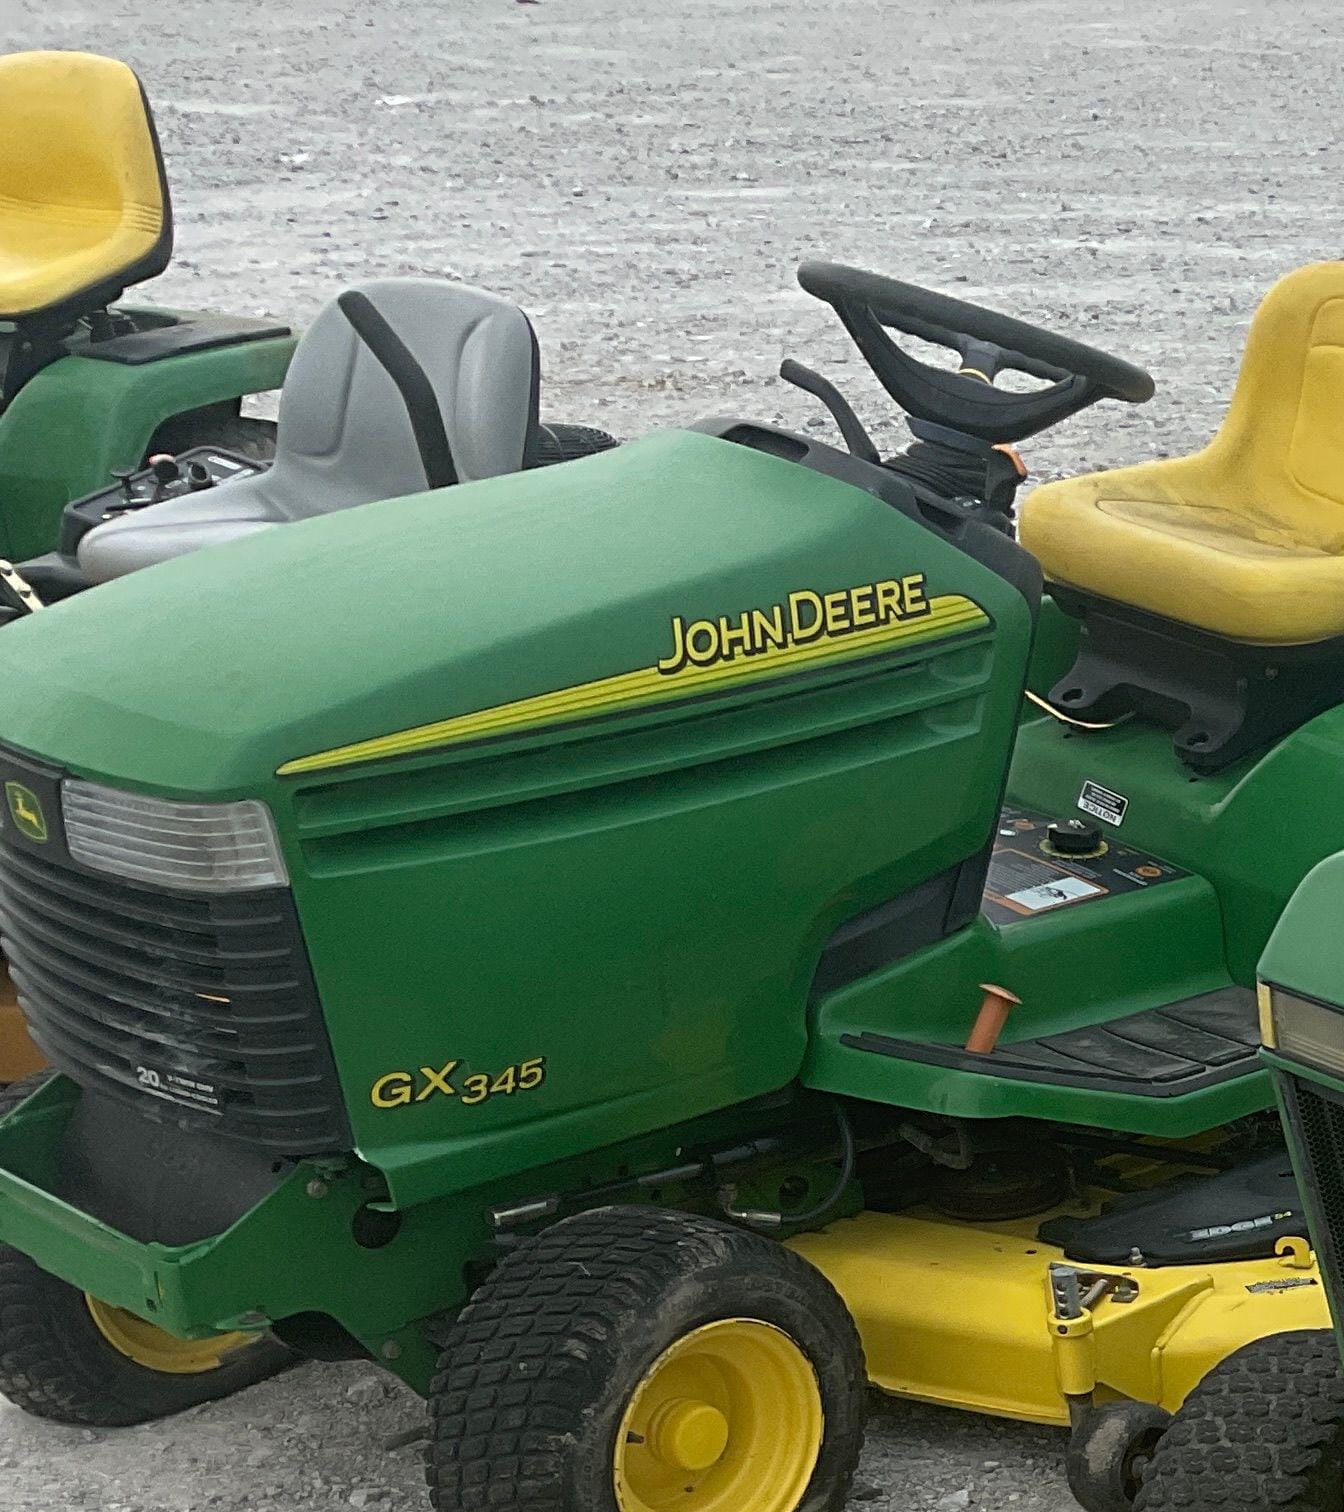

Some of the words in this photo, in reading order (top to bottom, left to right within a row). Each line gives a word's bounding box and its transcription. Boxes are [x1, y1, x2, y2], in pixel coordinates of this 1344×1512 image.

[658, 604, 786, 675] JOHN
[788, 573, 931, 645] DEERE
[136, 1065, 160, 1088] 20
